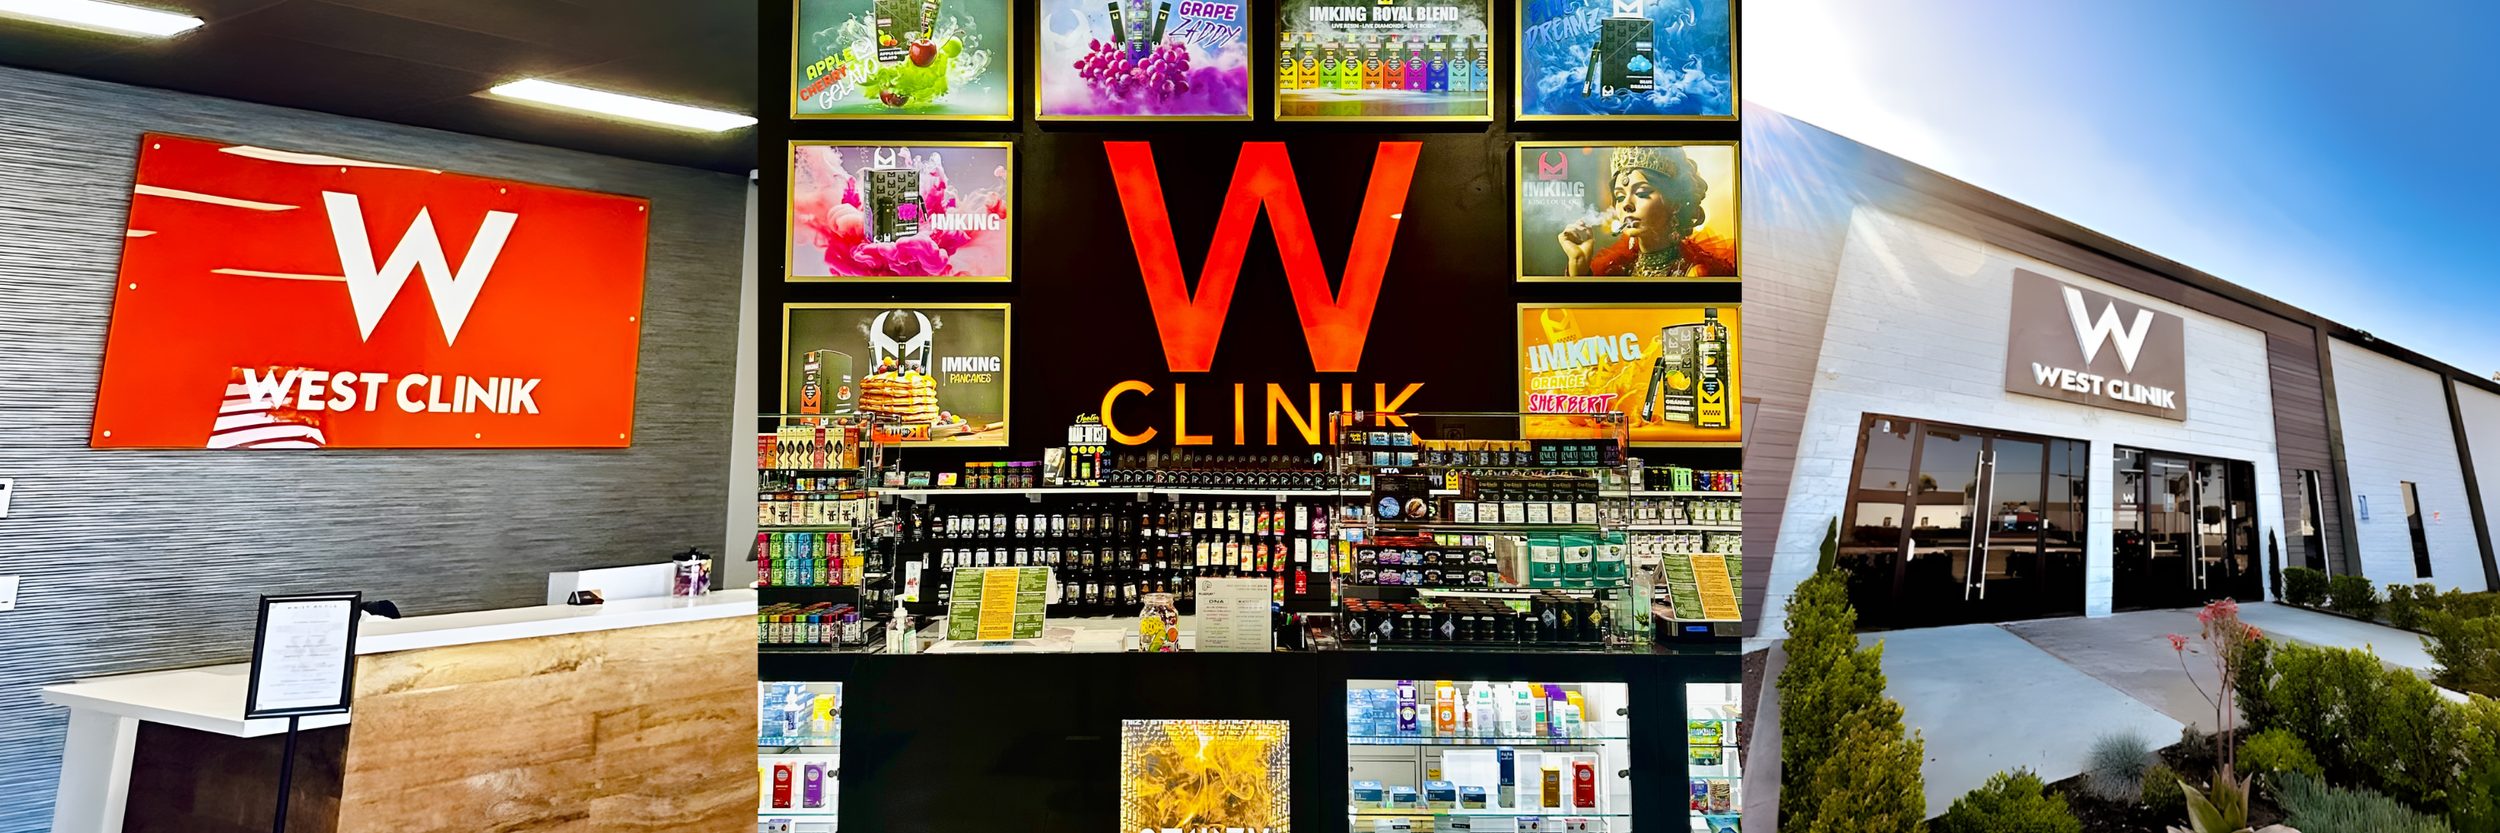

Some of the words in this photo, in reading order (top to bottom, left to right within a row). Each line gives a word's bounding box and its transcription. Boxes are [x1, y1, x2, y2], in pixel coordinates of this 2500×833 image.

[1179, 1, 1239, 21] GRAPE
[1309, 7, 1367, 21] IMKING
[1373, 7, 1414, 21] ROYAL
[1417, 7, 1459, 21] BLEND
[1525, 8, 1603, 49] DREAMZ
[1168, 16, 1241, 48] ZADDY
[806, 46, 855, 81] APPLE
[800, 64, 847, 101] CHERRY
[1523, 181, 1585, 198] IMKING
[931, 213, 1000, 231] IMKING
[322, 190, 518, 347] W
[1103, 141, 1423, 372] W
[2061, 285, 2155, 374] W
[941, 357, 1000, 373] IMKING
[1528, 333, 1641, 374] IMKING
[243, 368, 389, 412] WEST
[396, 373, 541, 414] CLINIK
[950, 373, 991, 383] PANCAKES
[1531, 375, 1585, 390] ORANGE
[2032, 362, 2104, 395] WEST
[2108, 379, 2176, 410] CLINIK
[1101, 380, 1425, 445] CLINIK
[1528, 394, 1618, 413] SHERBERT
